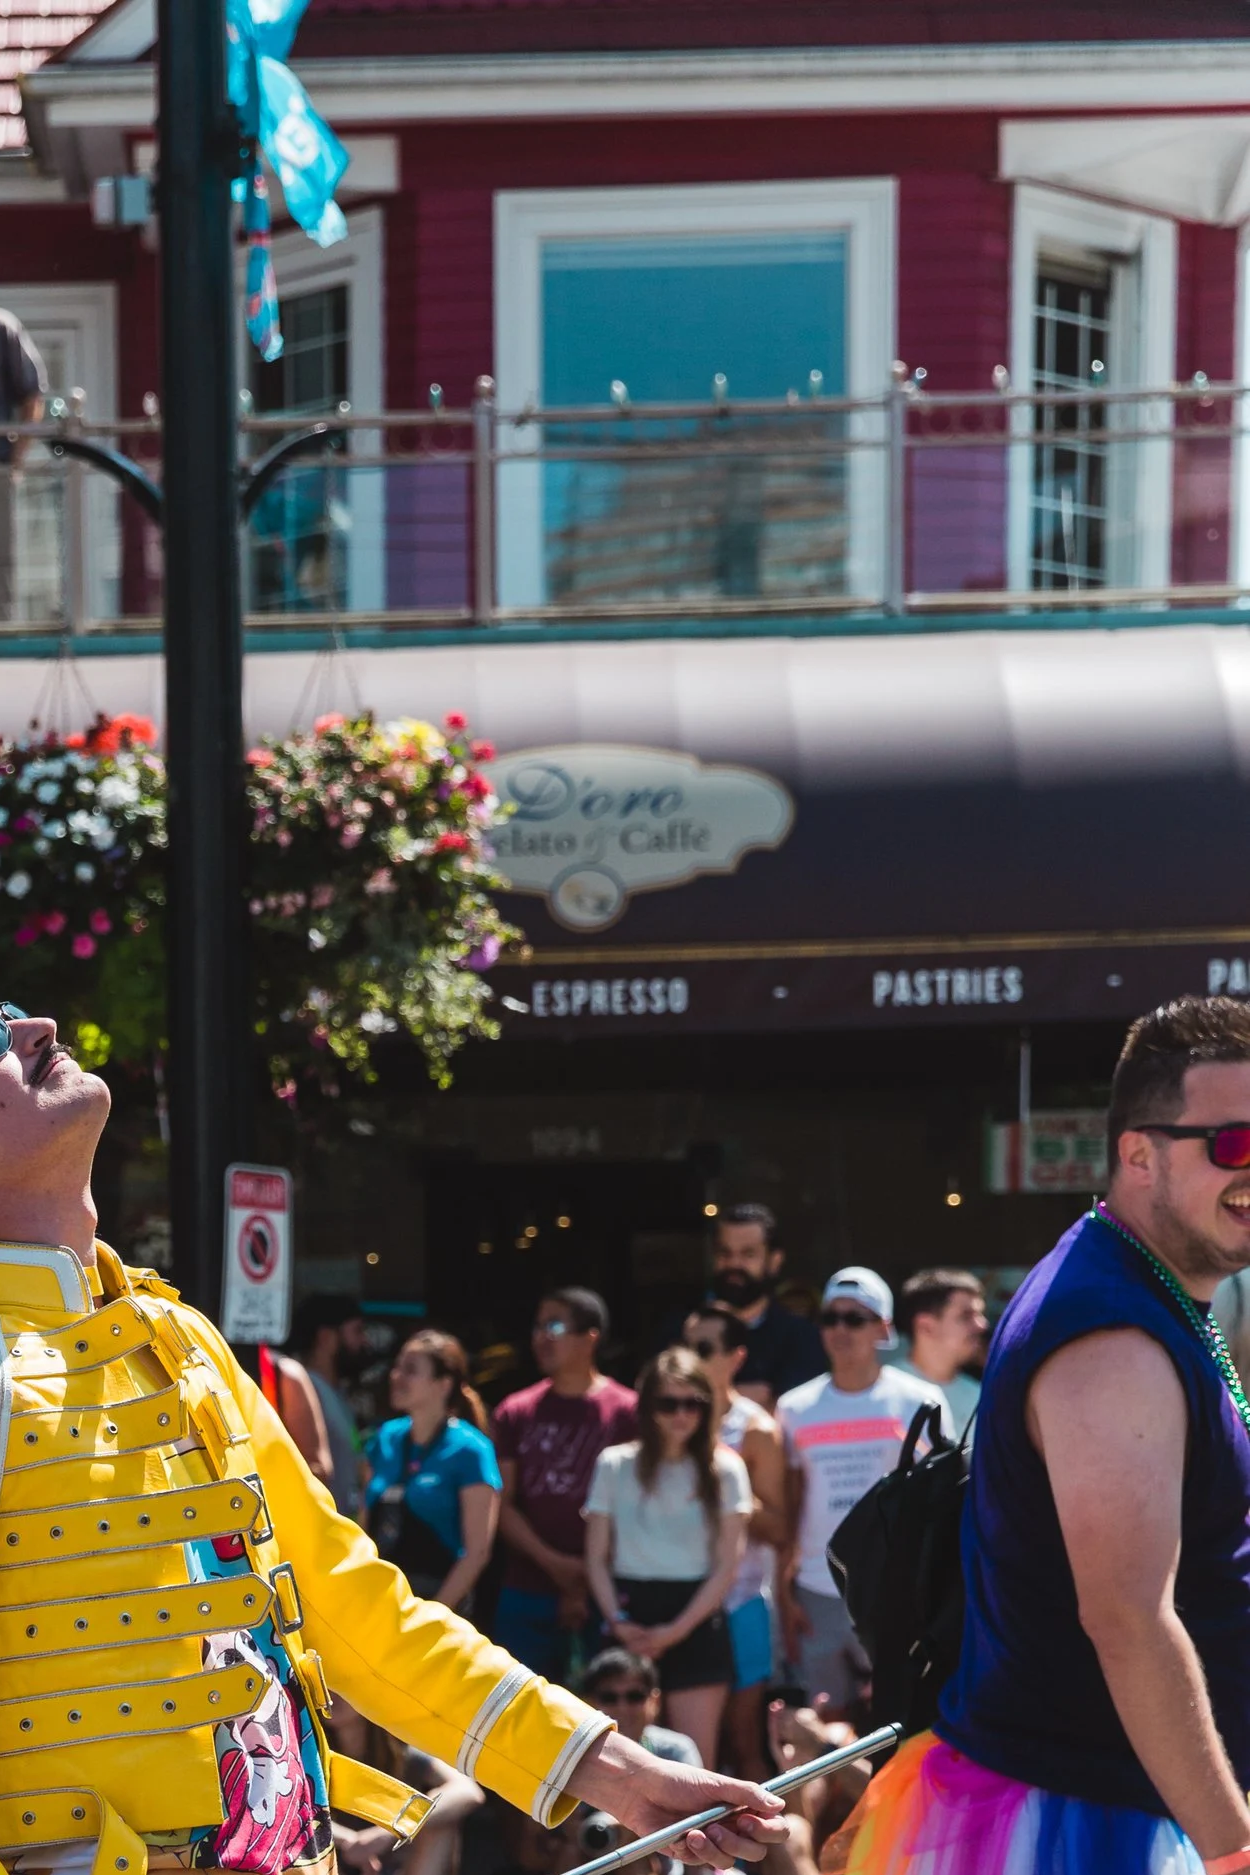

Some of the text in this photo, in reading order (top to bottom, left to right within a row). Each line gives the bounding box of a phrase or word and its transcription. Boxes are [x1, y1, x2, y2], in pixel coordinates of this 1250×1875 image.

[492, 823, 579, 857] elato
[532, 957, 1250, 1018] ESPRESSO PASTRIES PA
